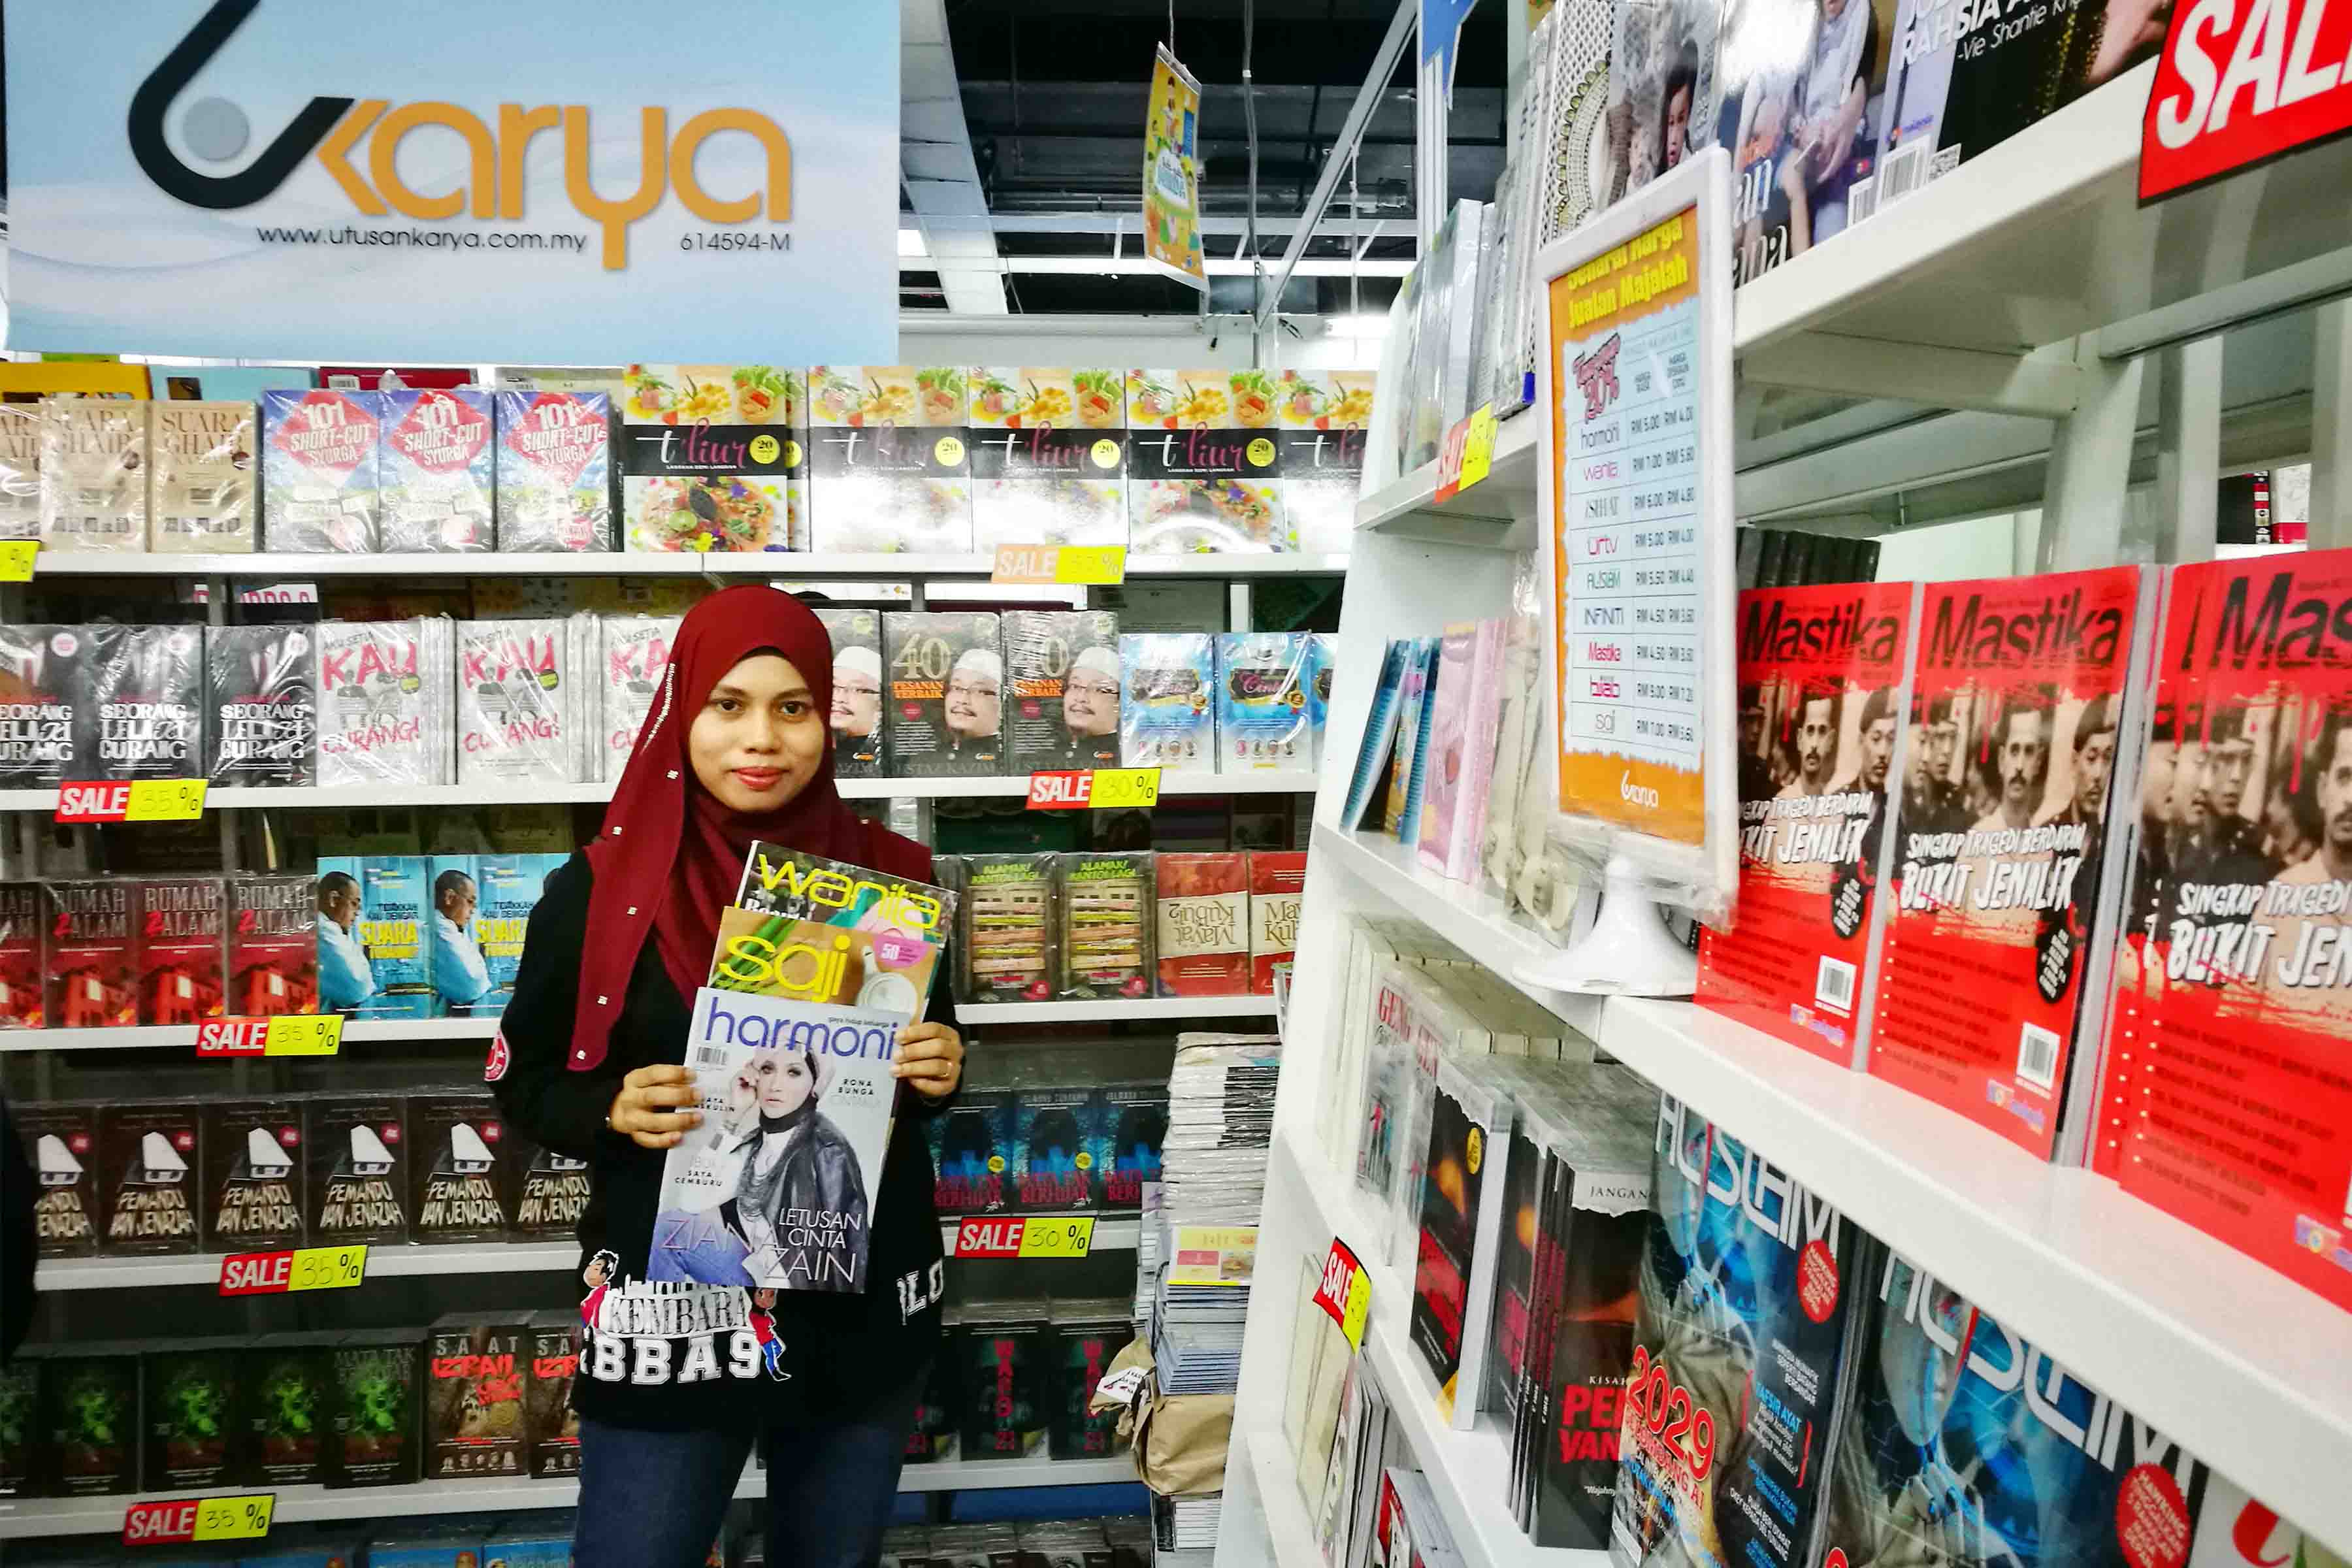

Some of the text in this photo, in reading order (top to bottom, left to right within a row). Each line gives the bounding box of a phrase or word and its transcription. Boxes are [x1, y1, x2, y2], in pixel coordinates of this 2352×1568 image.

[2157, 0, 2352, 149] SAL
[257, 225, 586, 253] www.utusankarya.com.my
[679, 232, 790, 251] 614594-M
[1620, 252, 1689, 308] Majalah
[303, 403, 346, 429] 101
[289, 424, 371, 452] SHORT-CUT
[998, 550, 1056, 577] SALE
[1740, 597, 1899, 665] Mastika
[1927, 587, 2125, 670] Mastika
[322, 639, 417, 691] KAU
[462, 634, 555, 691] KAU
[610, 638, 671, 686] KA
[892, 632, 952, 679] 40
[0, 704, 73, 721] EORANG
[100, 704, 188, 720] SEORANG
[220, 704, 305, 720] SEORANG
[100, 740, 187, 759] CURANG
[61, 786, 129, 816] SALE
[1031, 776, 1091, 802] SALE
[1739, 826, 1778, 864] KIT
[1907, 821, 2088, 859] SINGKAP TRAGEDI BERDARAH
[144, 885, 222, 911] RUMAH
[758, 853, 942, 930] wanita
[1901, 862, 1974, 911] BUKIT
[2176, 883, 2264, 918] SINGKAP
[145, 910, 221, 936] 2 ALAM
[237, 909, 257, 932] 2
[1176, 922, 1238, 945] Mayat
[880, 942, 899, 960] 50
[2167, 918, 2278, 985] BUKIT
[719, 934, 852, 1004] saji
[200, 1024, 266, 1050] SALE
[704, 996, 898, 1061] harmoni
[778, 1207, 862, 1231] LETUSAN
[787, 1229, 847, 1250] CINTA
[960, 1224, 1023, 1250] SALE
[1030, 1228, 1060, 1247] 30
[224, 1257, 290, 1290] SALE
[763, 1247, 858, 1284] ZAIN
[1322, 1250, 1354, 1316] SALE
[608, 1290, 749, 1335] KEMBARA
[1626, 1344, 1716, 1481] 2029
[128, 1507, 195, 1539] SALE
[205, 1510, 236, 1529] 35
